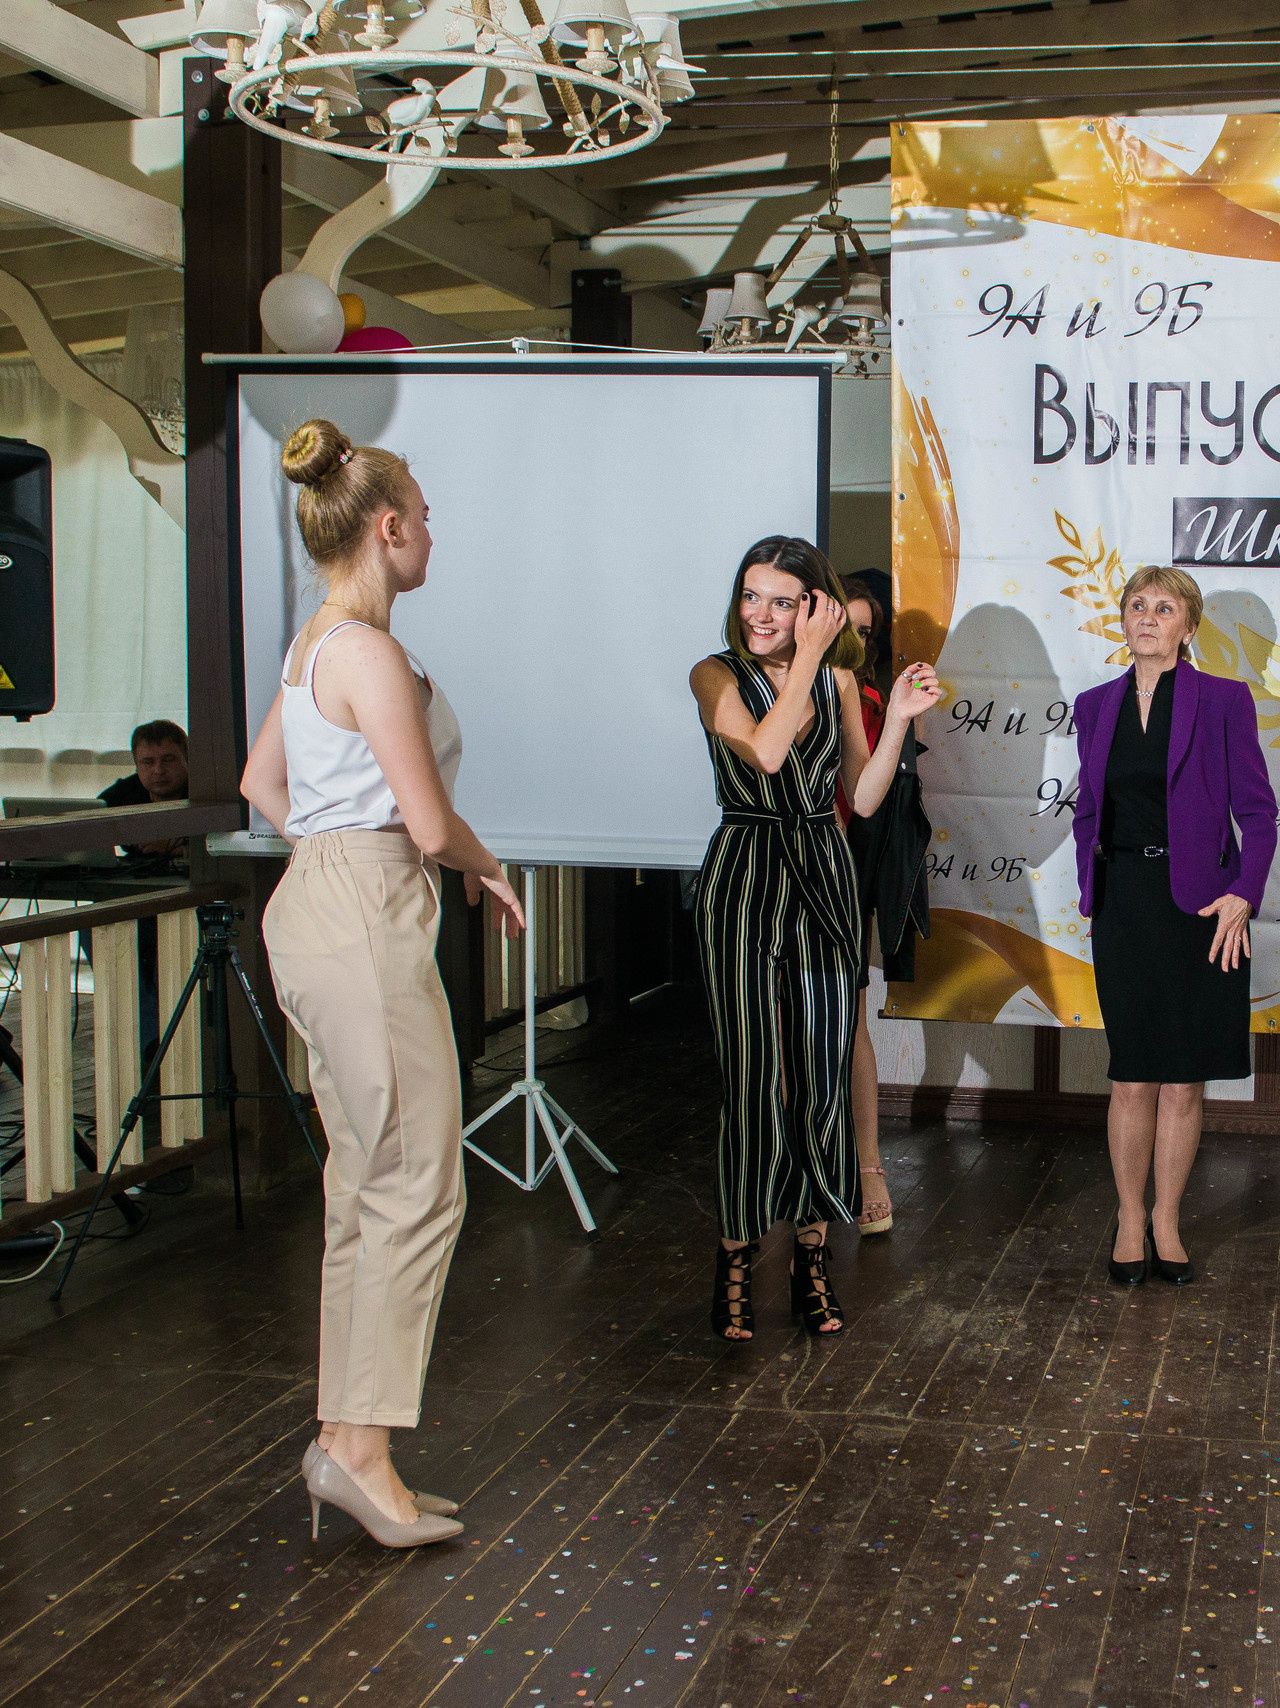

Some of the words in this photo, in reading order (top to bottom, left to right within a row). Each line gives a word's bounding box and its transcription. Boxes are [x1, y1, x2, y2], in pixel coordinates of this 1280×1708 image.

[968, 283, 1050, 338] 9А
[1065, 301, 1106, 339] и
[1124, 281, 1213, 338] 9Б
[946, 699, 995, 735] 9А
[1003, 712, 1029, 736] и
[961, 863, 980, 882] и
[986, 856, 1027, 883] 9Б
